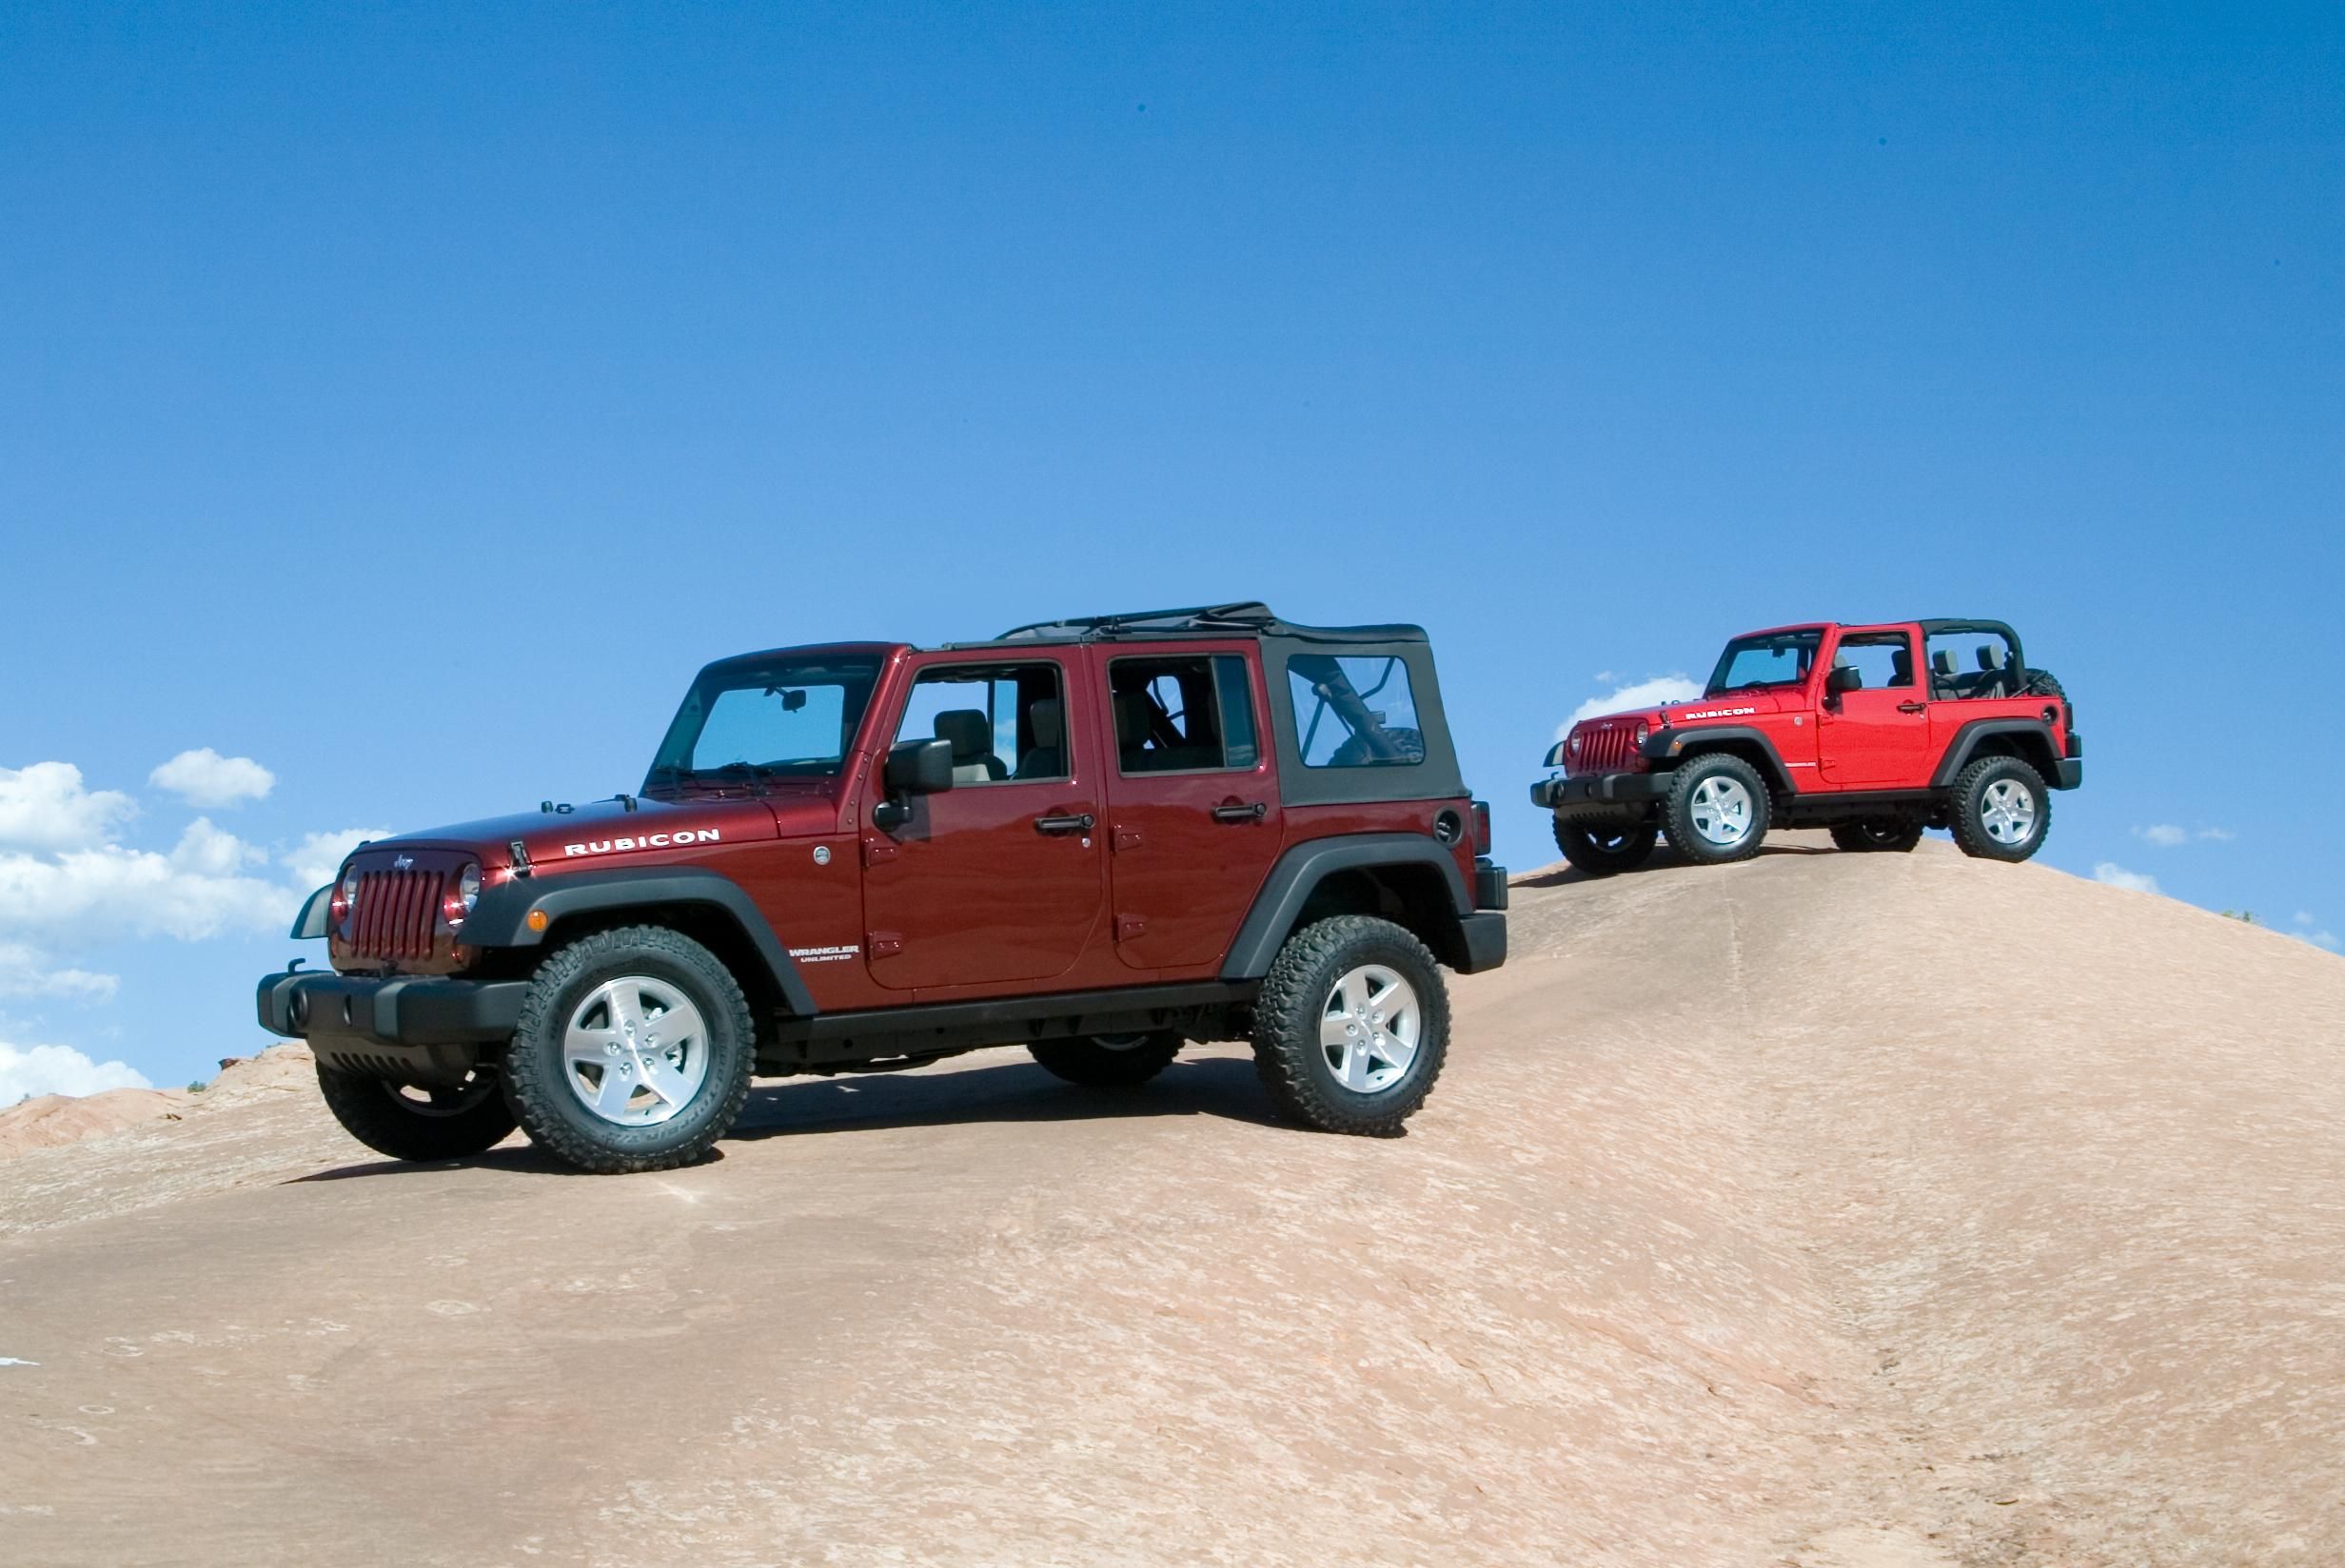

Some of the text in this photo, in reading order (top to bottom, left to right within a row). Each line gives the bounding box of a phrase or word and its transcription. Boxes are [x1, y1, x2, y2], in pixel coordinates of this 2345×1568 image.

[1685, 707, 1755, 719] RUBICON
[563, 828, 720, 856] RUBICON
[789, 945, 860, 957] WRANGLER
